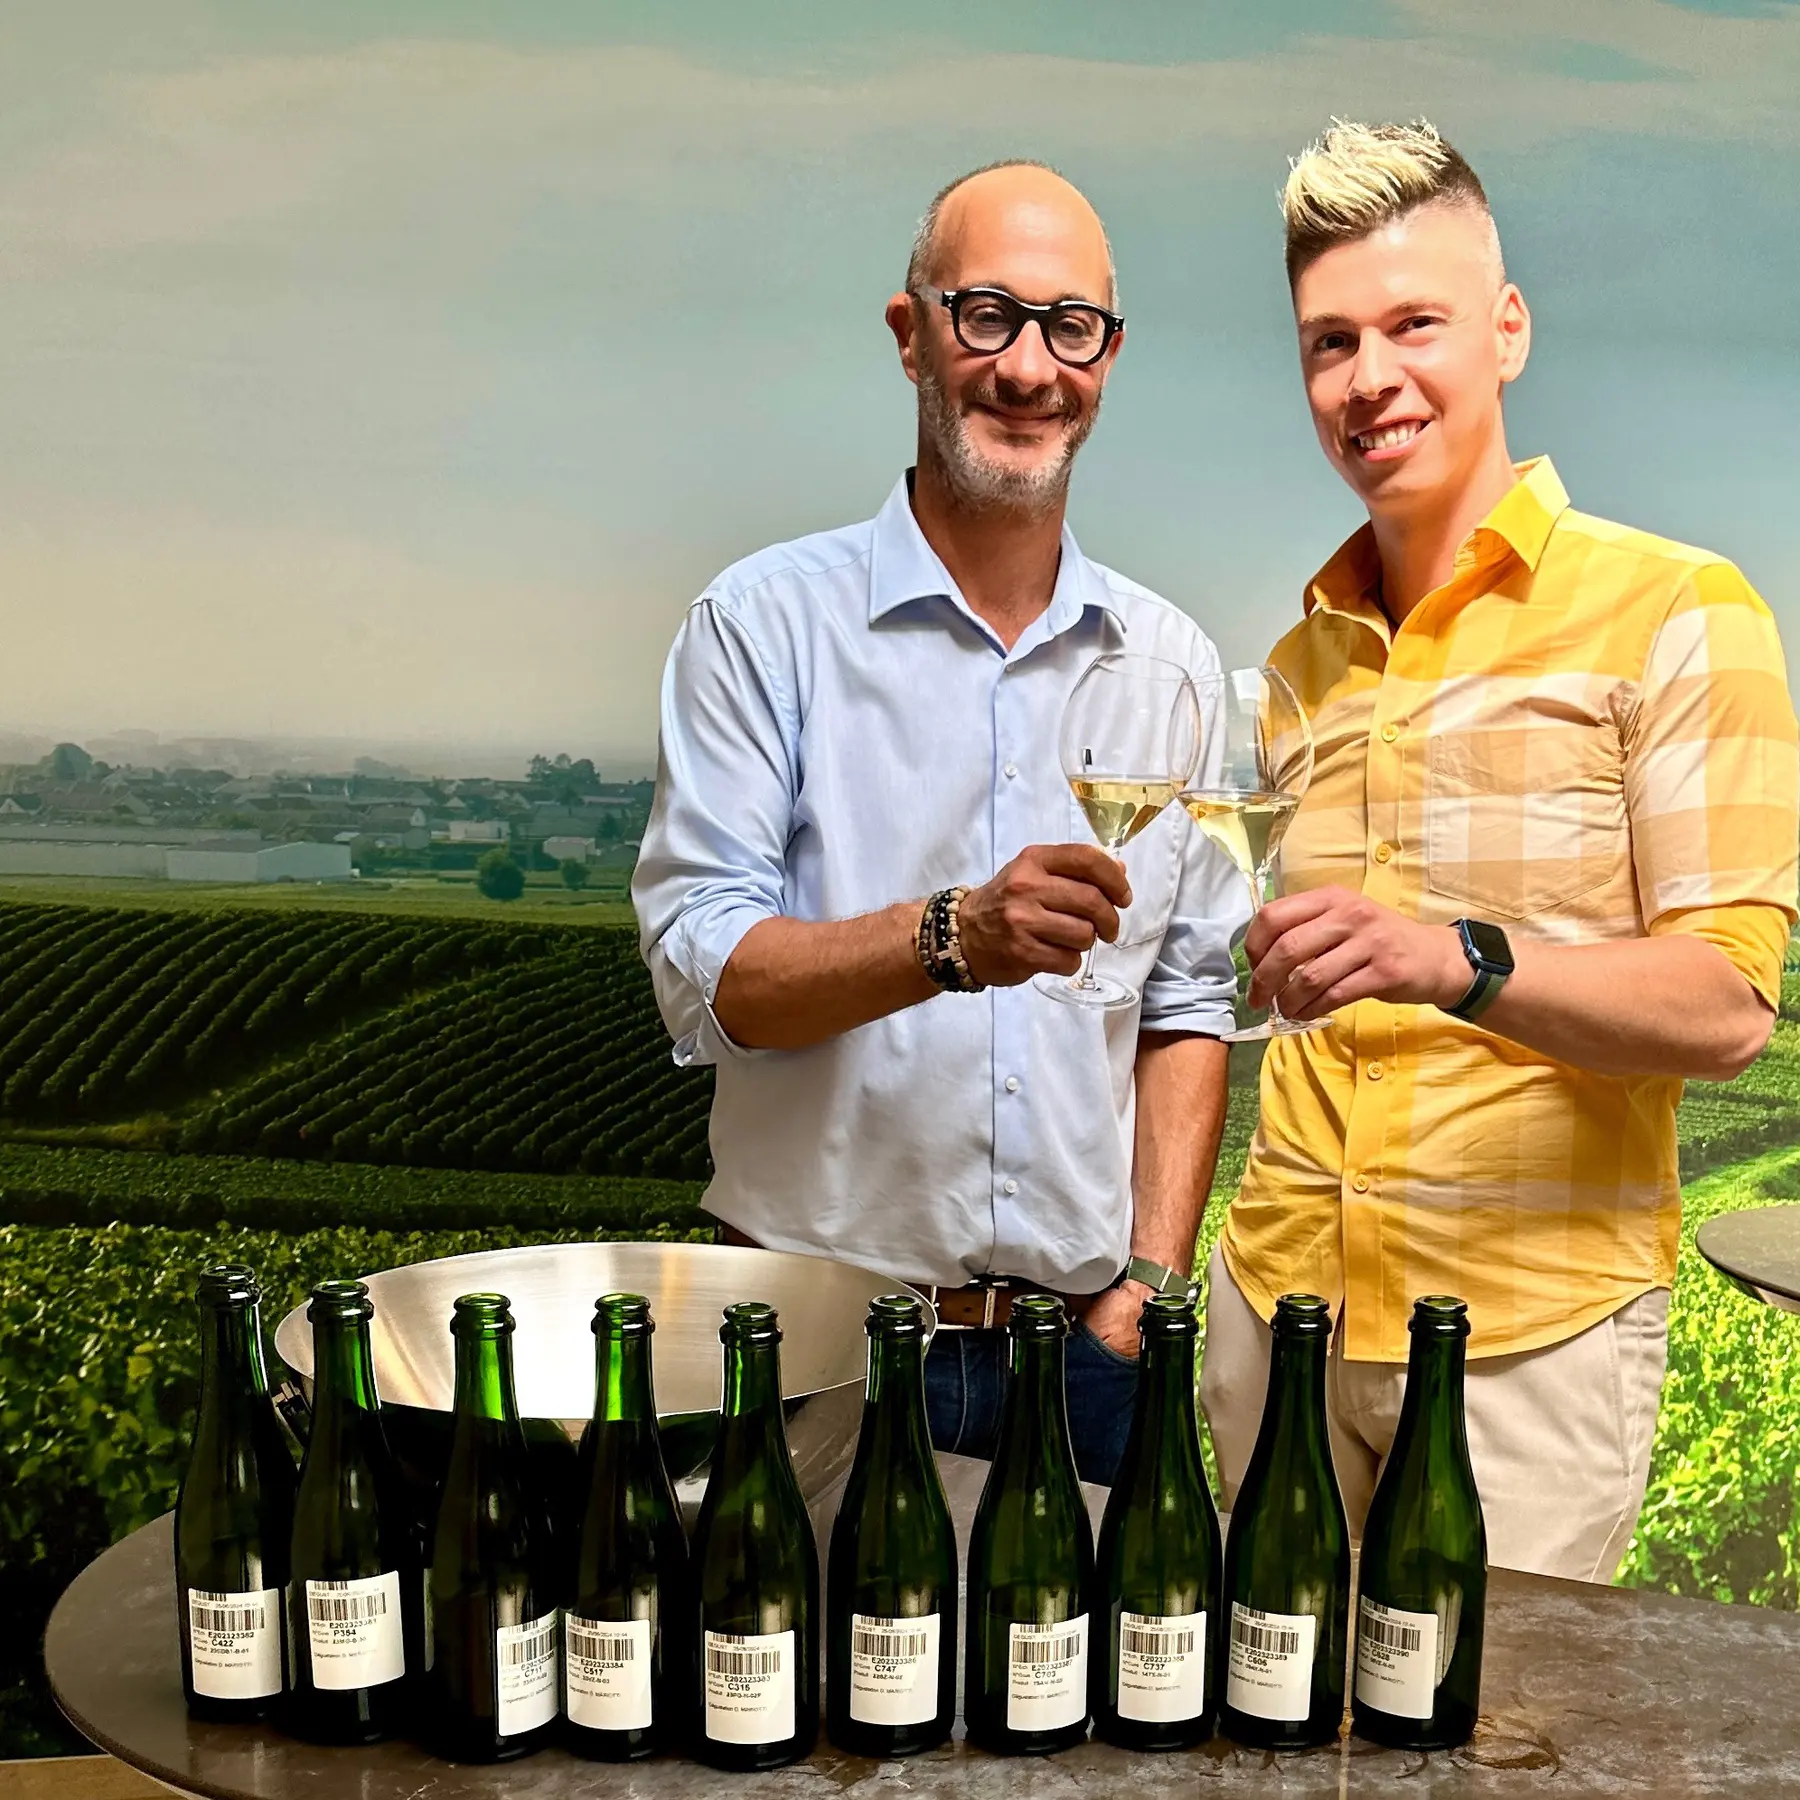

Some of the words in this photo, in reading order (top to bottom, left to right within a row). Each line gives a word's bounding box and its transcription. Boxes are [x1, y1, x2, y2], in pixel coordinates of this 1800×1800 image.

[211, 1639, 234, 1647] C422
[584, 1667, 604, 1676] C517
[1035, 1671, 1056, 1679] C703
